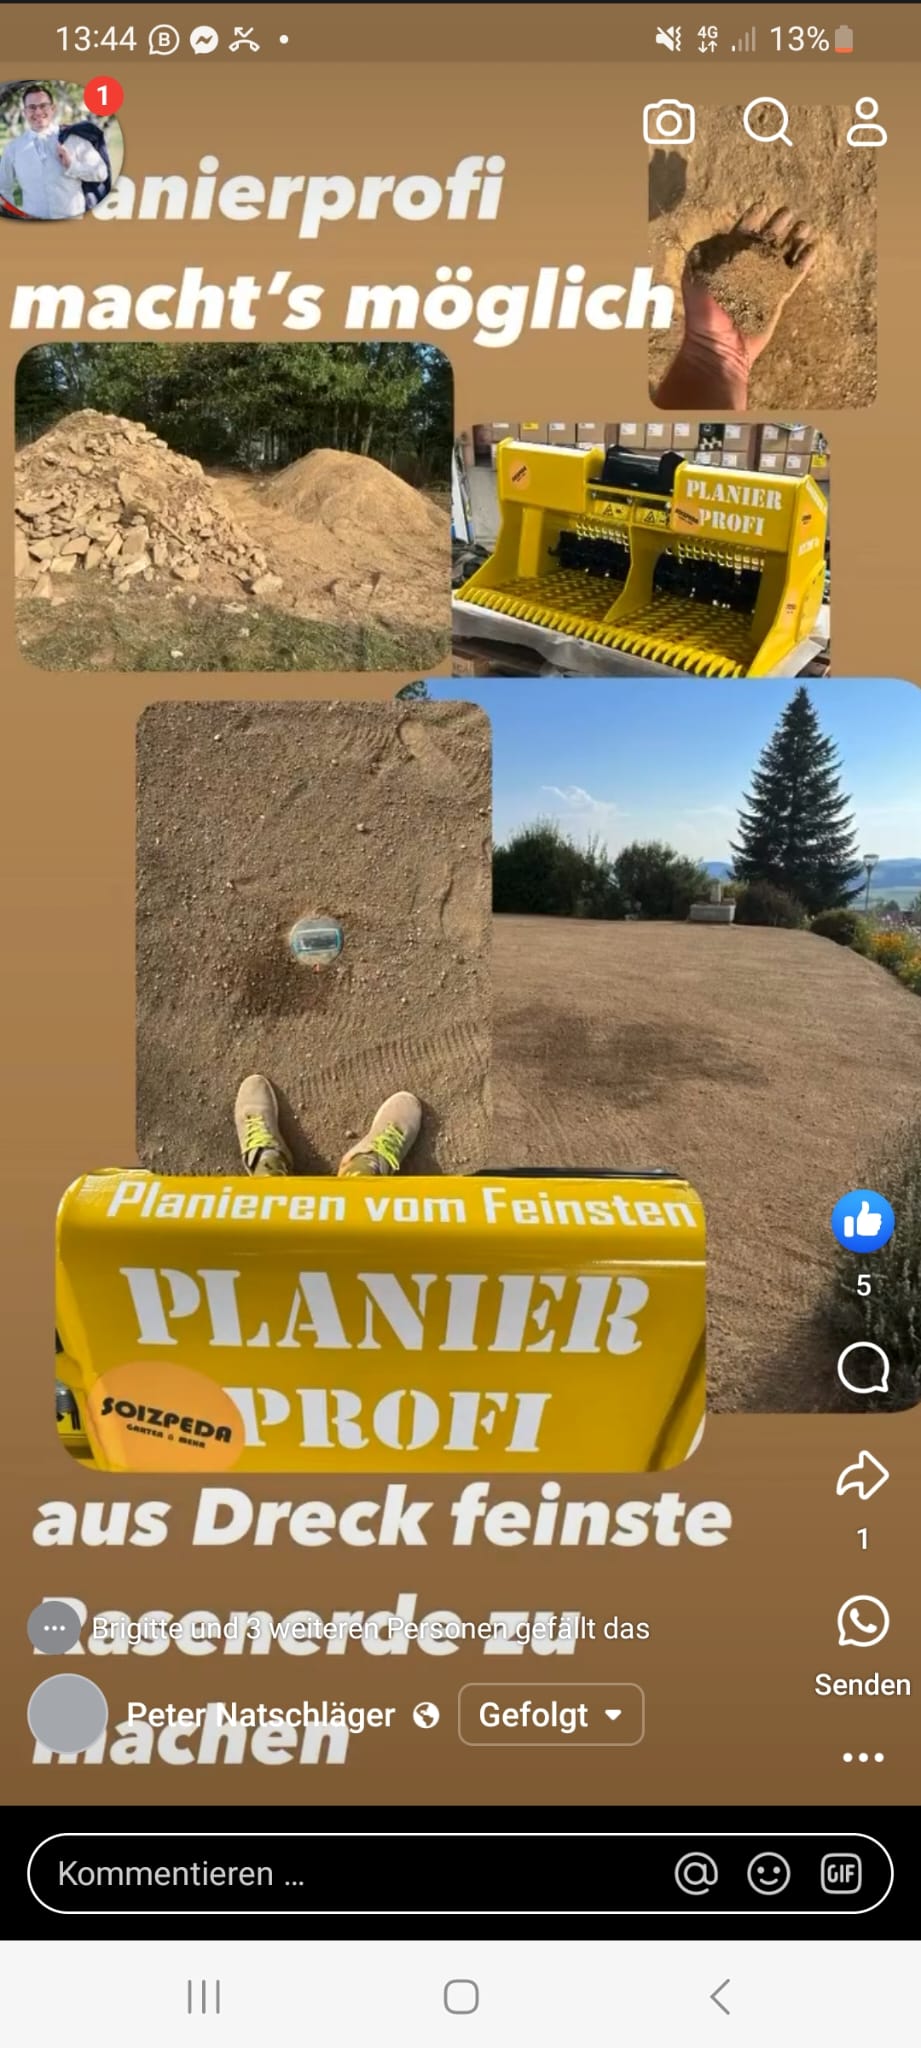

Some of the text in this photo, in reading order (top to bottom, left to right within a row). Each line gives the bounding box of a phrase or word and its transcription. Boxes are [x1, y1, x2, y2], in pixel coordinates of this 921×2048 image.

[686, 479, 783, 511] PLANIER
[699, 508, 765, 537] PROFI
[106, 1180, 696, 1228] Planieren vom Feinsten
[119, 1266, 651, 1356] PLANIER
[101, 1396, 232, 1444] SOIZPEDA
[222, 1386, 553, 1452] PROFI
